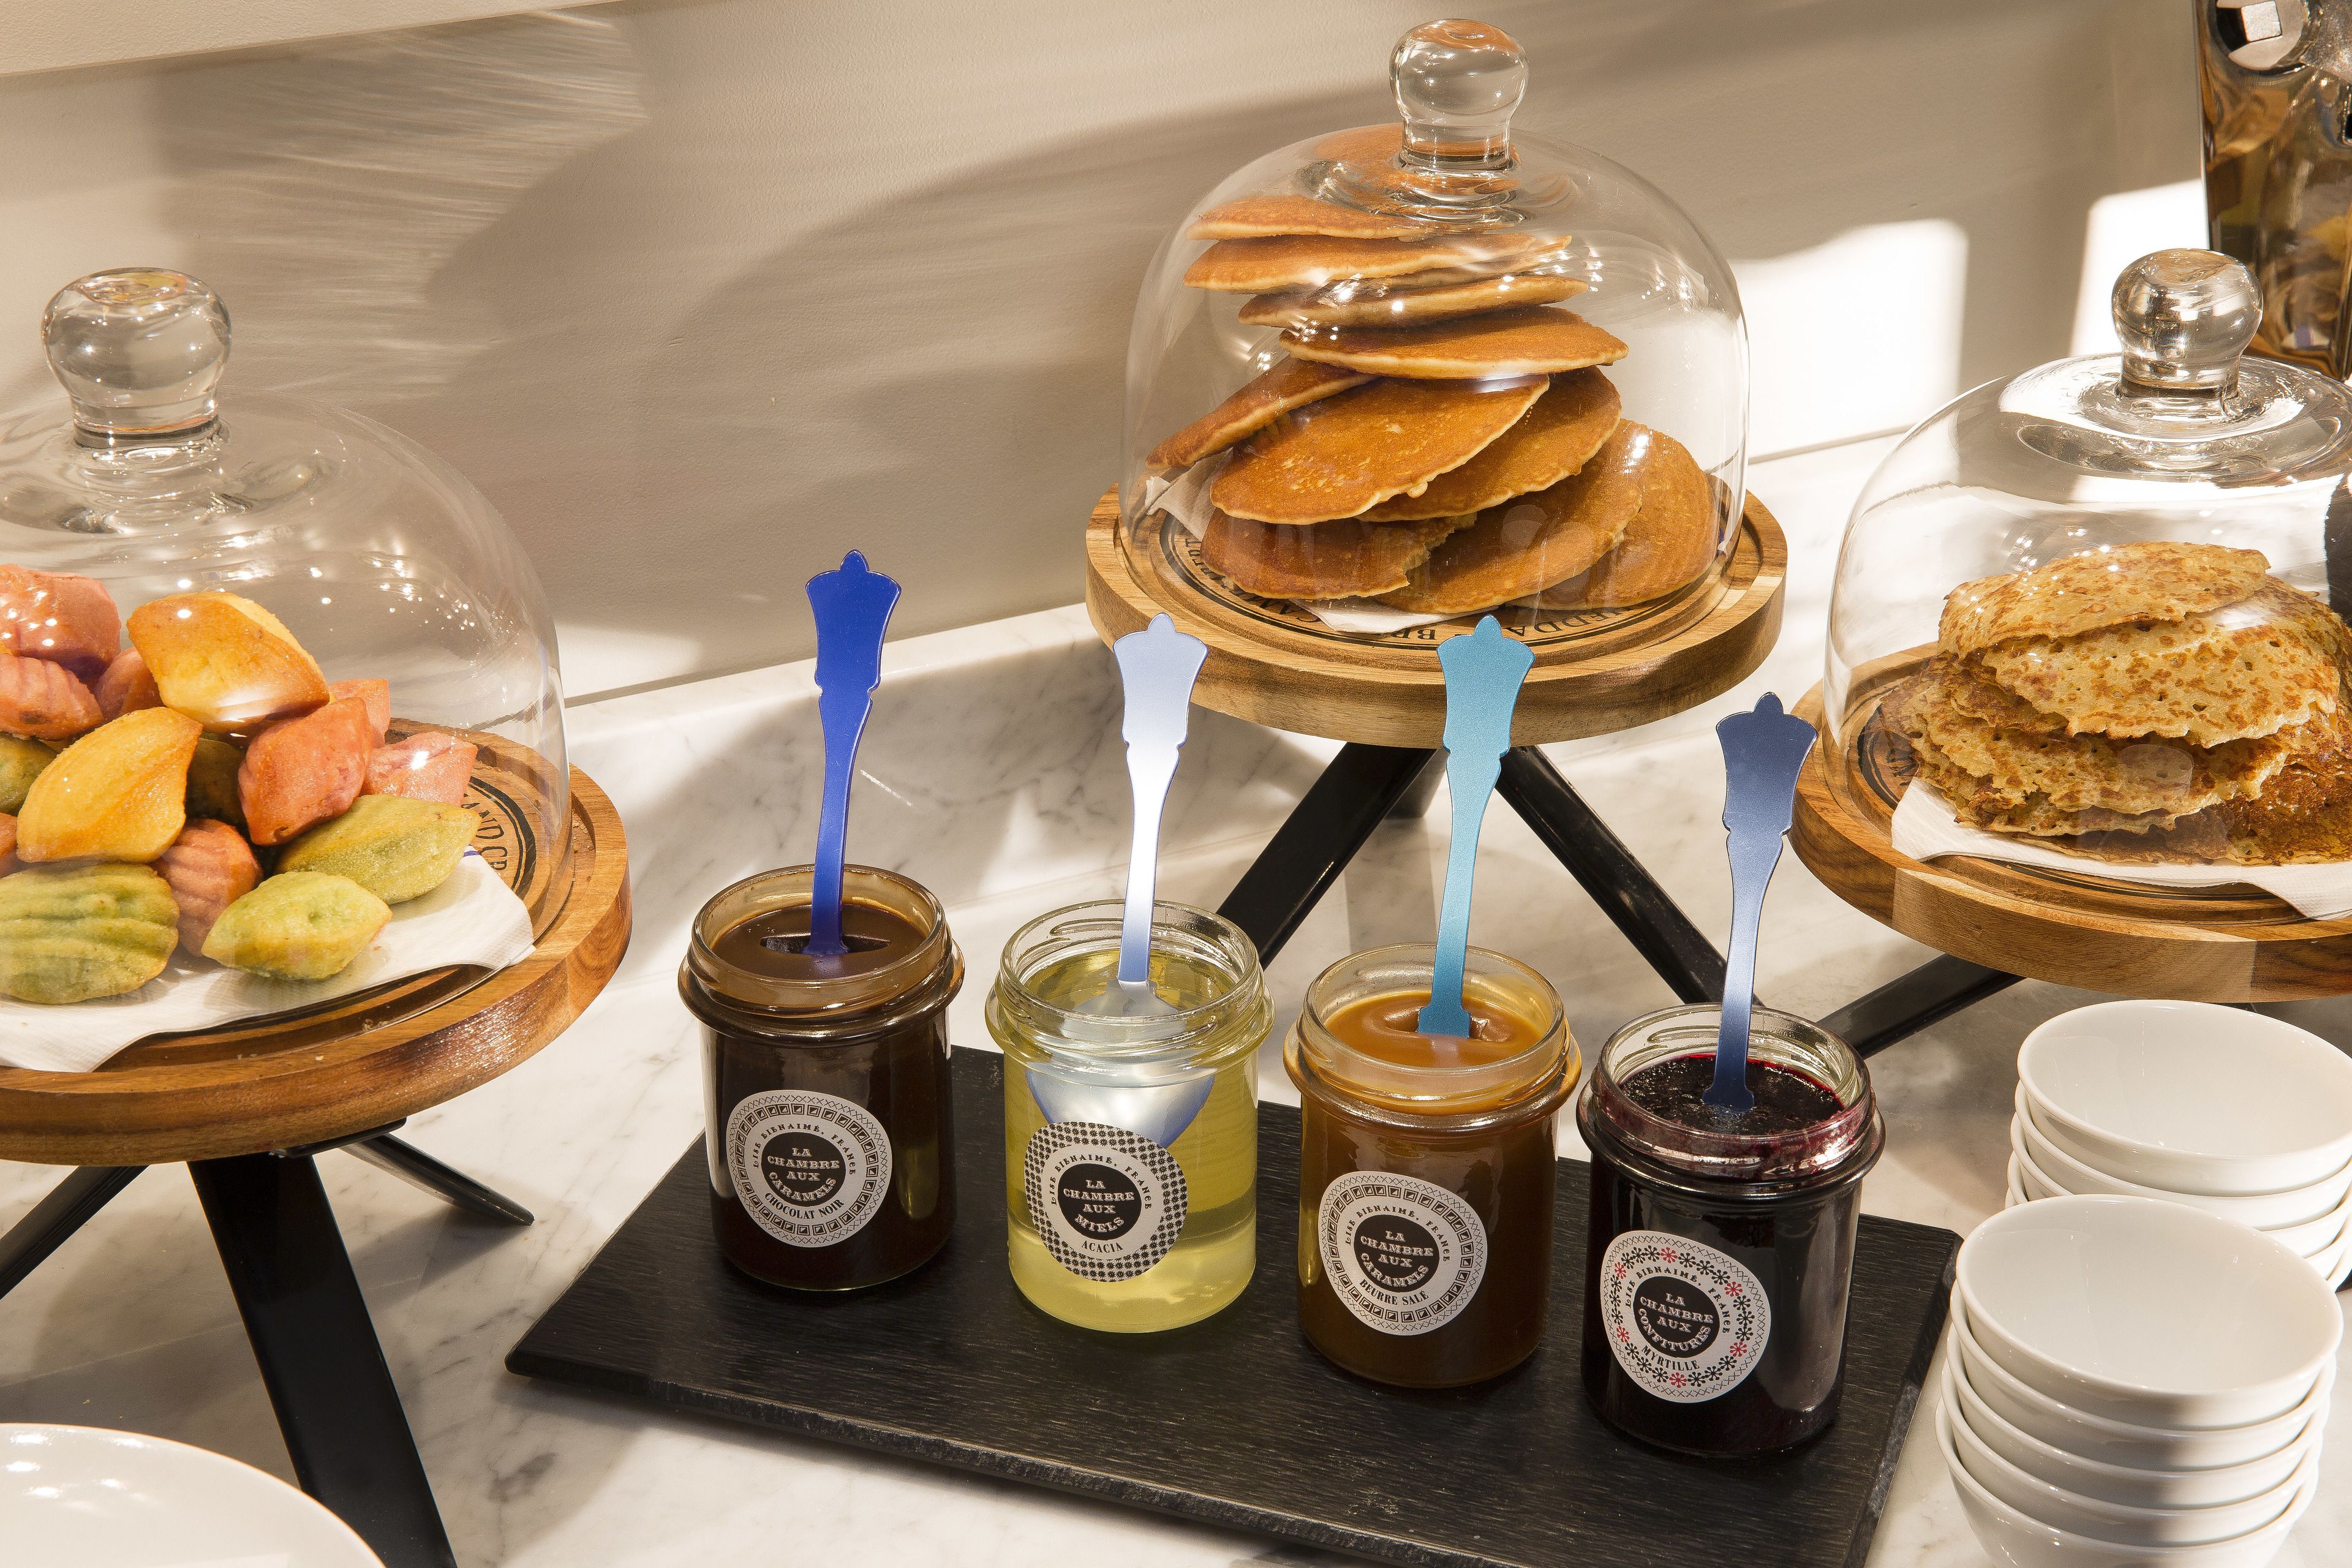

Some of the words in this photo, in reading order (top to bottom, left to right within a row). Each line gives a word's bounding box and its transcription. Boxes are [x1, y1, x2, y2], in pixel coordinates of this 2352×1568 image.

[791, 1148, 812, 1157] LA
[831, 1134, 856, 1175] FRANCE
[767, 1156, 840, 1169] CHAMBRE
[786, 1171, 820, 1181] AUX
[1086, 1180, 1106, 1189] LA
[769, 1172, 836, 1202] CARAMELS
[1048, 1177, 1057, 1205] LISE
[1125, 1166, 1152, 1210] FRANCE
[1063, 1189, 1134, 1201] CHAMBRE
[765, 1193, 815, 1219] CHOCOLAT
[818, 1199, 845, 1217] NOIR
[1083, 1204, 1116, 1213] AUX
[1075, 1214, 1125, 1232] MIELS
[1345, 1219, 1355, 1246] LISE
[1425, 1220, 1450, 1262] FRANCE
[1360, 1236, 1434, 1256] CHAMBRE
[1385, 1231, 1406, 1242] LA
[1082, 1240, 1123, 1253] ACACIA
[1361, 1253, 1428, 1287] CARAMELS
[1378, 1255, 1413, 1268] AUX
[1359, 1279, 1398, 1305] BEURRE
[1403, 1291, 1428, 1306] SALÉ
[1665, 1293, 1685, 1306] LA
[1626, 1280, 1636, 1308] LISE
[1708, 1287, 1731, 1333] FRANCE
[1640, 1296, 1714, 1324] CHAMBRE
[1638, 1308, 1711, 1351] CONFITURES
[1657, 1317, 1691, 1333] AUX
[1642, 1345, 1700, 1371] MYRTILLE
